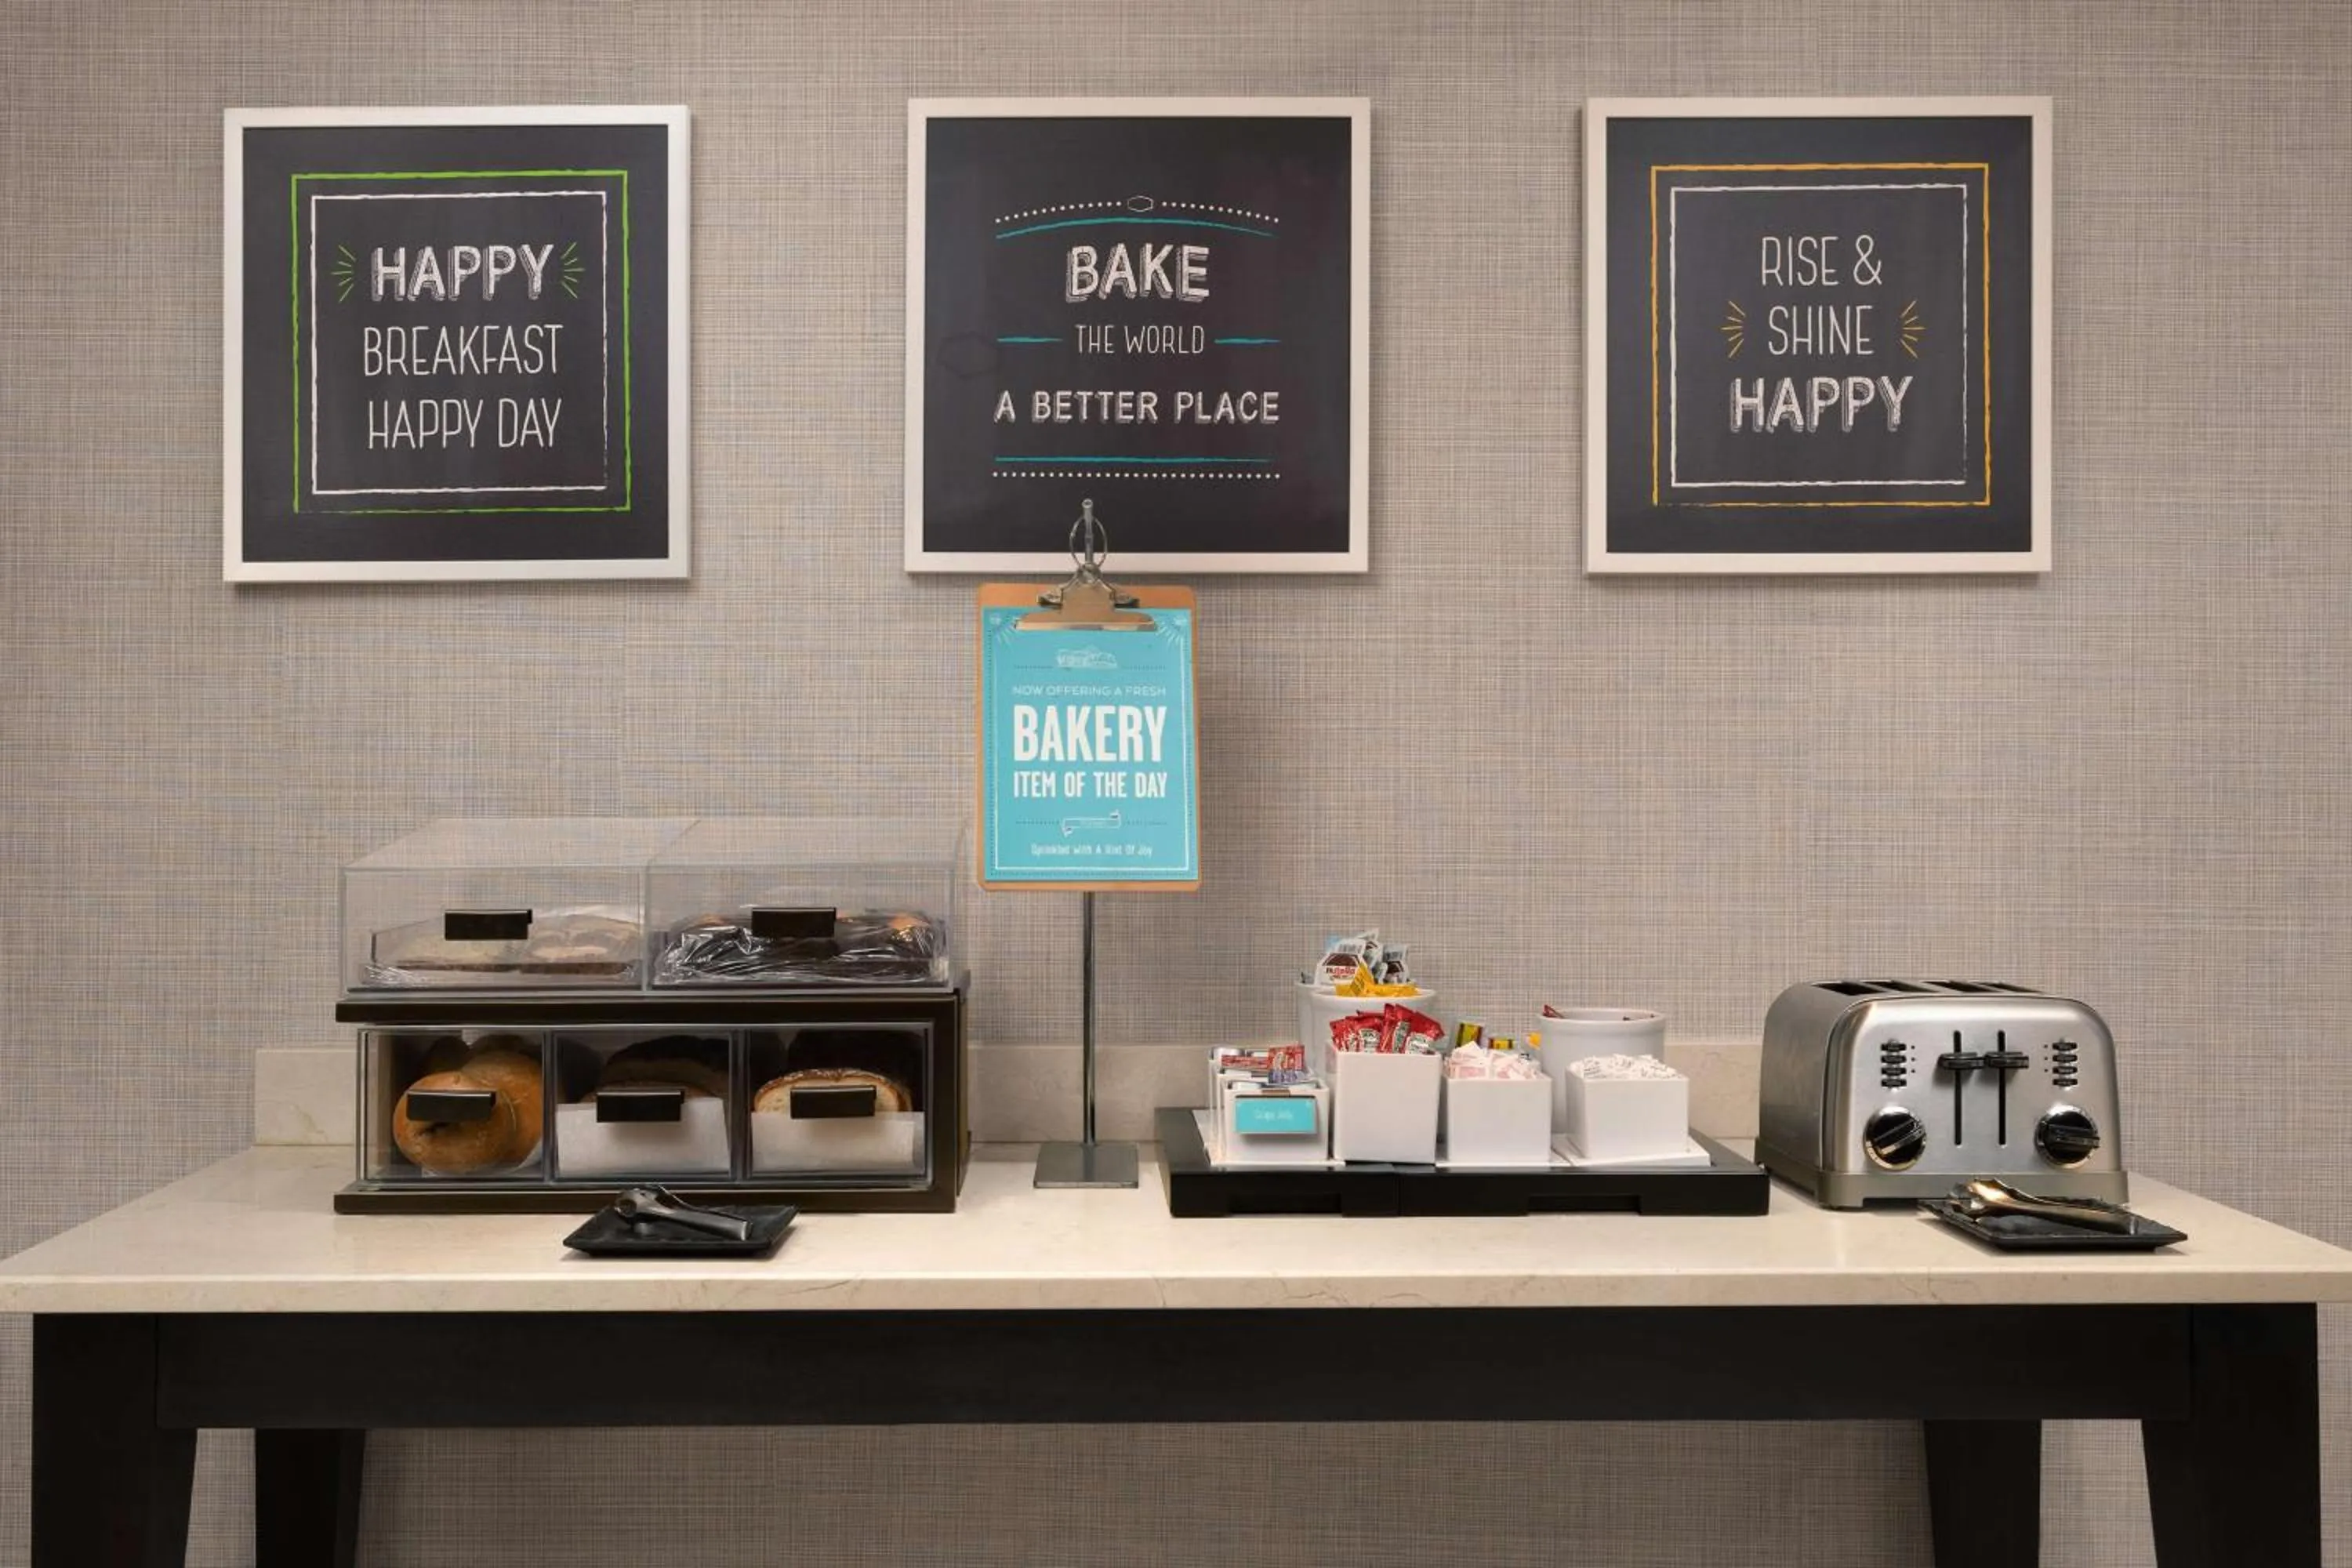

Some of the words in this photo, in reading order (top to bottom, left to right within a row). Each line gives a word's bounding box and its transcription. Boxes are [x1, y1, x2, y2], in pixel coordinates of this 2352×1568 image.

[372, 244, 554, 302] HAPPY
[1065, 242, 1210, 303] BAKE
[1762, 234, 1840, 286] RISE
[1853, 234, 1882, 285] &
[363, 324, 564, 376] BREAKFAST
[1074, 324, 1115, 354] THE
[1123, 325, 1206, 354] WORLD
[1768, 304, 1875, 355] SHINE
[368, 398, 484, 449] HAPPY
[498, 397, 562, 448] DAY
[993, 389, 1016, 424] A
[1031, 390, 1159, 425] BETTER
[1174, 390, 1280, 426] PLACE
[1730, 375, 1914, 434] HAPPY
[1011, 684, 1044, 697] NOW
[1046, 684, 1112, 697] OFFERING
[1113, 686, 1123, 696] A
[1124, 685, 1167, 697] FRESH
[1013, 704, 1167, 763] BAKERY
[1013, 770, 1057, 799] ITEM
[1063, 771, 1087, 799] OF
[1092, 771, 1128, 799] THE
[1134, 771, 1167, 799] DAY
